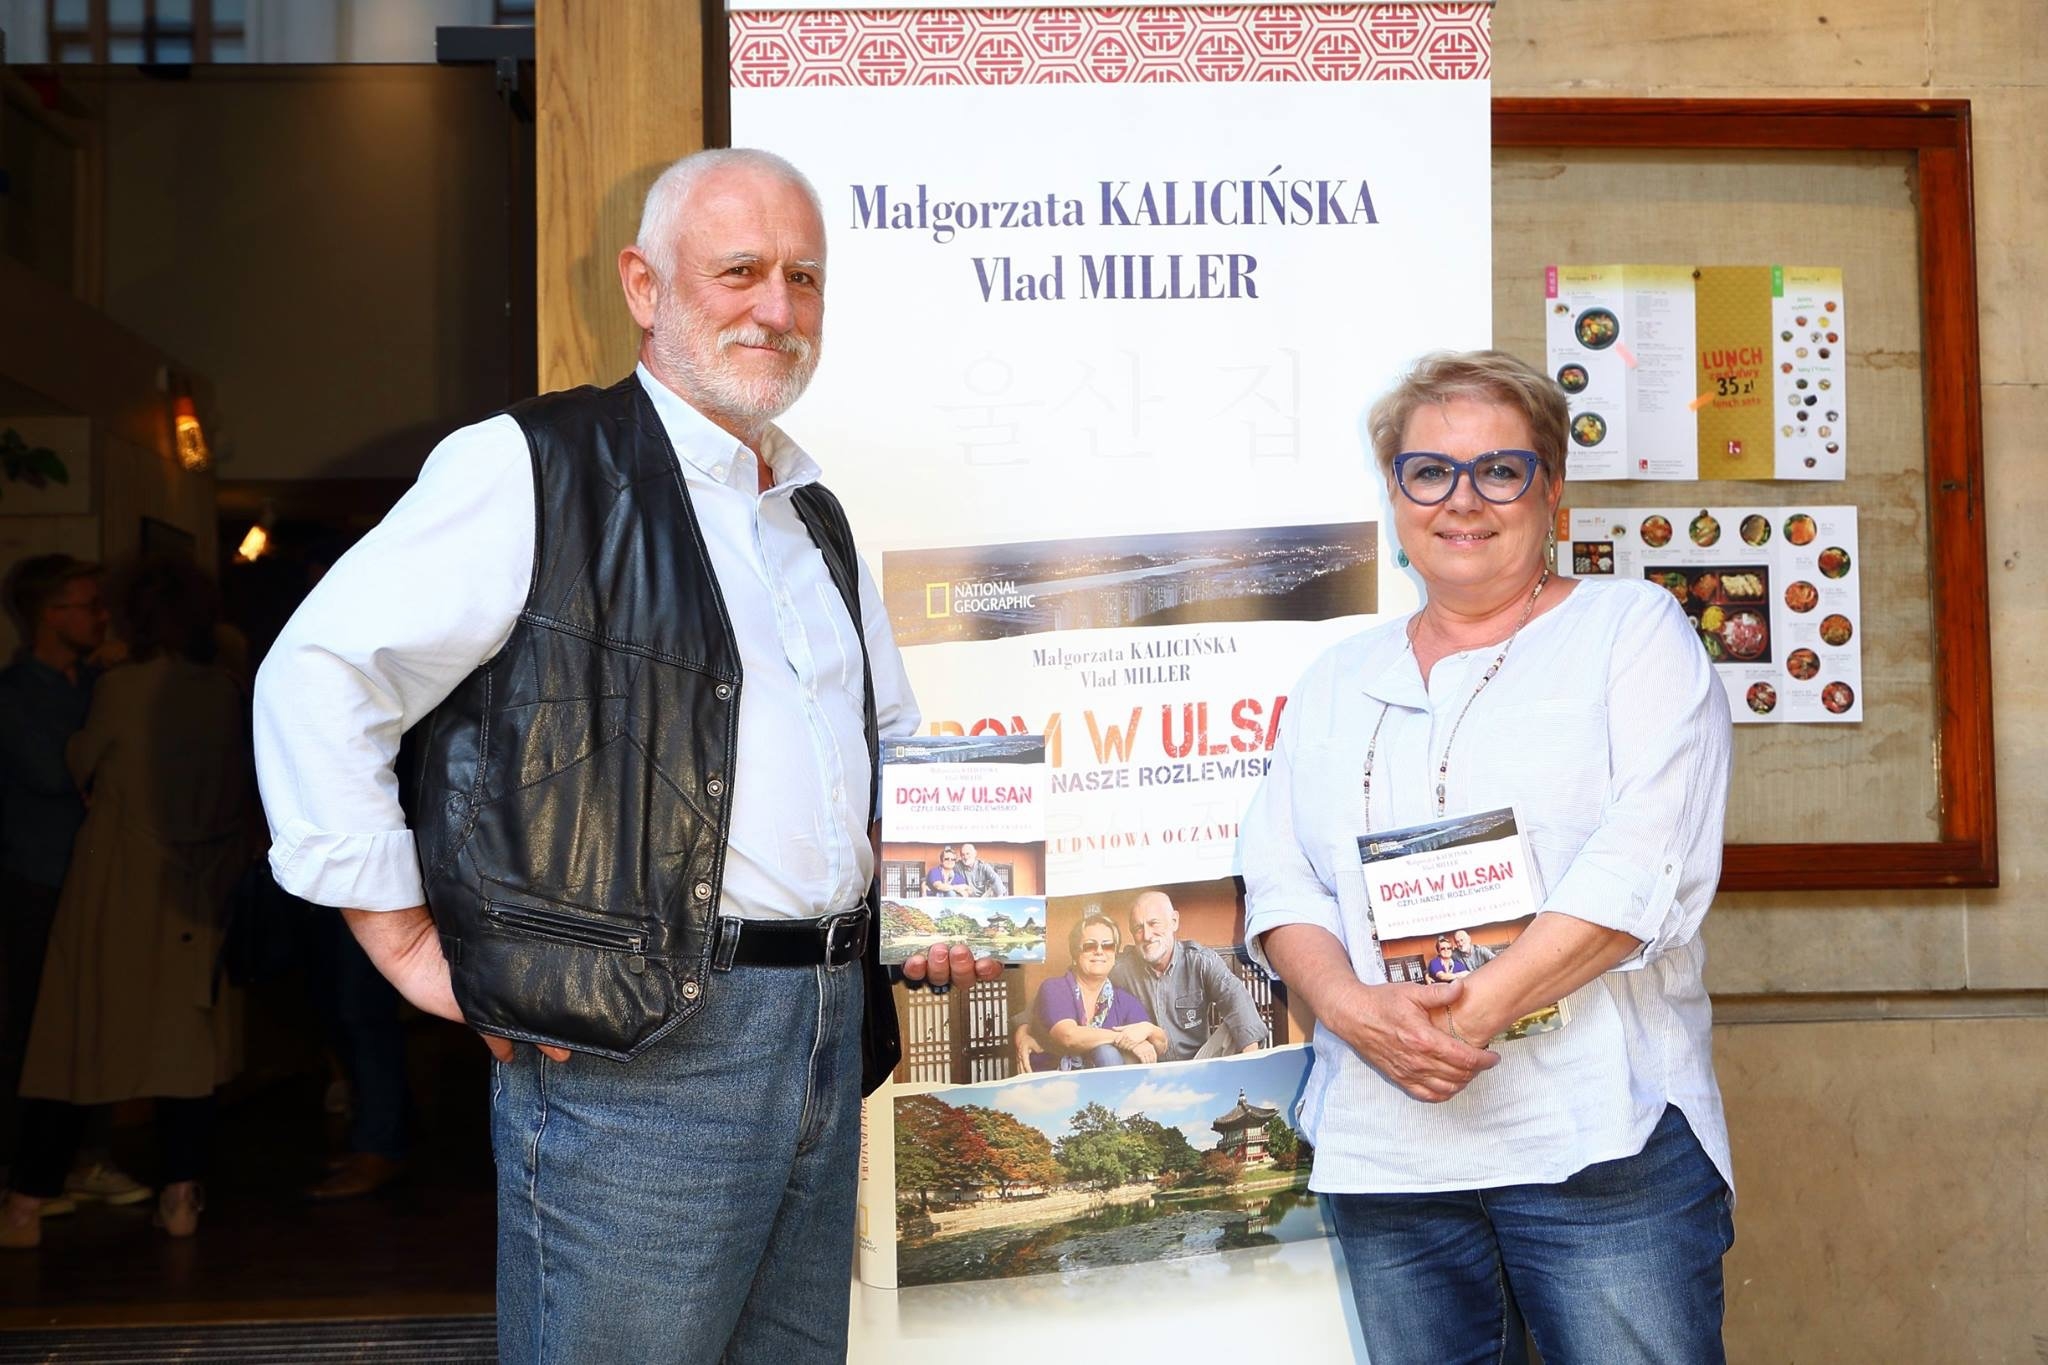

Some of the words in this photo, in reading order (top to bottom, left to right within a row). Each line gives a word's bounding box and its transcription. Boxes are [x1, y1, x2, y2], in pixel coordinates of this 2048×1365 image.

[849, 184, 1085, 244] Małgorzata
[1098, 164, 1380, 228] KALICIŃSKA
[971, 254, 1066, 303] Vlad
[1080, 253, 1260, 301] MILLER
[1701, 347, 1764, 370] LUNCH
[1716, 376, 1740, 396] 35
[954, 581, 1019, 598] NATIONAL
[953, 594, 1036, 614] GEOGRAPHIC
[1130, 632, 1238, 660] KALICIŃSKA
[1080, 669, 1117, 688] Vlad
[1123, 663, 1191, 685] MILLER
[1083, 706, 1143, 765] W
[1051, 768, 1130, 794] NASZE
[896, 787, 939, 804] DOM
[947, 786, 966, 803] W
[971, 786, 1032, 803] ULSAN
[1161, 822, 1240, 845] OCZAMI
[1380, 879, 1423, 902] DOM
[1426, 874, 1445, 894] W
[1451, 861, 1514, 890] ULSAN
